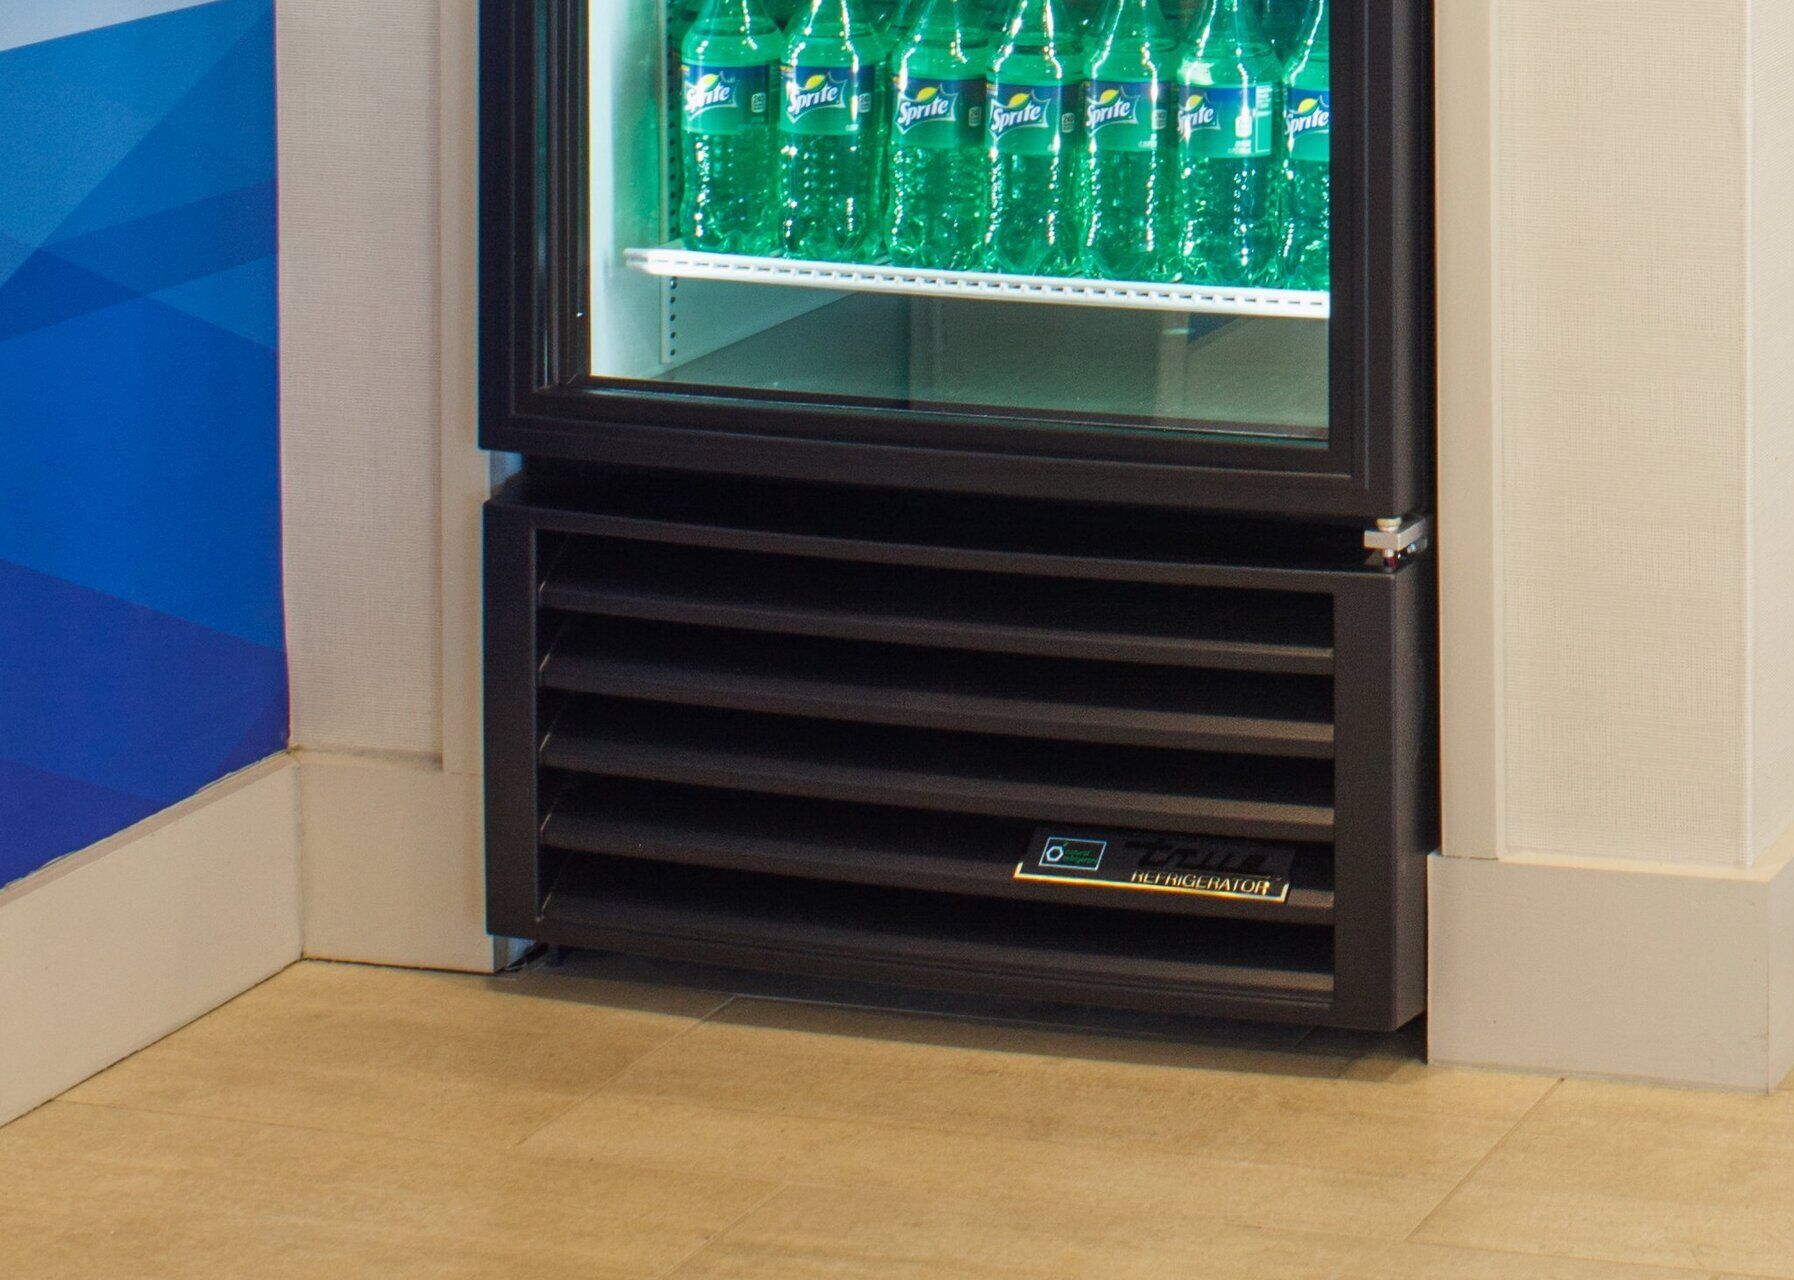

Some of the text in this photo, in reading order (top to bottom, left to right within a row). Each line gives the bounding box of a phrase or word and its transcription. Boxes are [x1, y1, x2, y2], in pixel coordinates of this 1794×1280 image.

[685, 82, 730, 114] Sprite
[788, 83, 838, 115] Sprite
[897, 97, 949, 126] Sprite
[990, 99, 1042, 132] Sprite
[1086, 99, 1131, 129] Sprite
[1130, 871, 1271, 896] REFRIGERATOR
